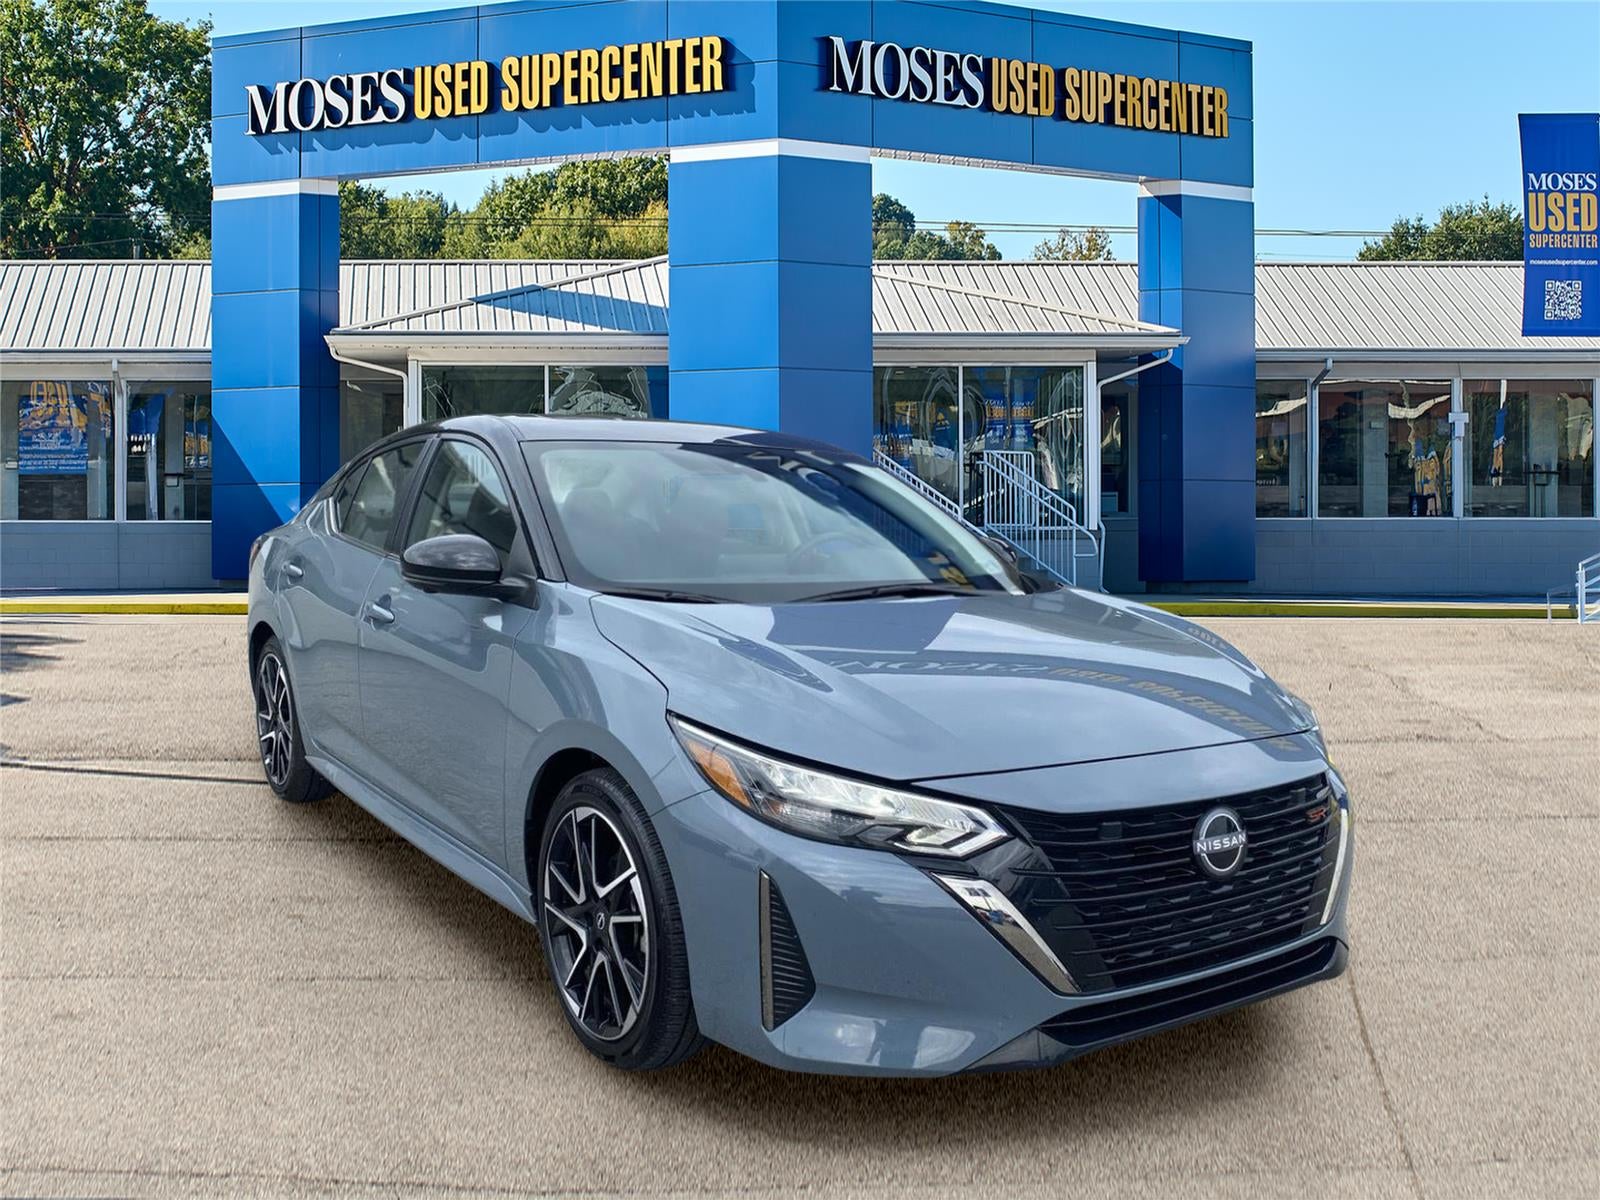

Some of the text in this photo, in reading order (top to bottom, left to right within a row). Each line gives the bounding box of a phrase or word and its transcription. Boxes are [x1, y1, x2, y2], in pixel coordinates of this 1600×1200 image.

[245, 35, 724, 136] MOSES USED SUPERCENTER
[828, 35, 1229, 138] MOSES USED SUPERCENTER
[1527, 172, 1597, 191] MOSES
[1528, 192, 1598, 232] USED
[1529, 233, 1598, 249] SUPERCENTER
[1196, 832, 1247, 853] NISSAN
